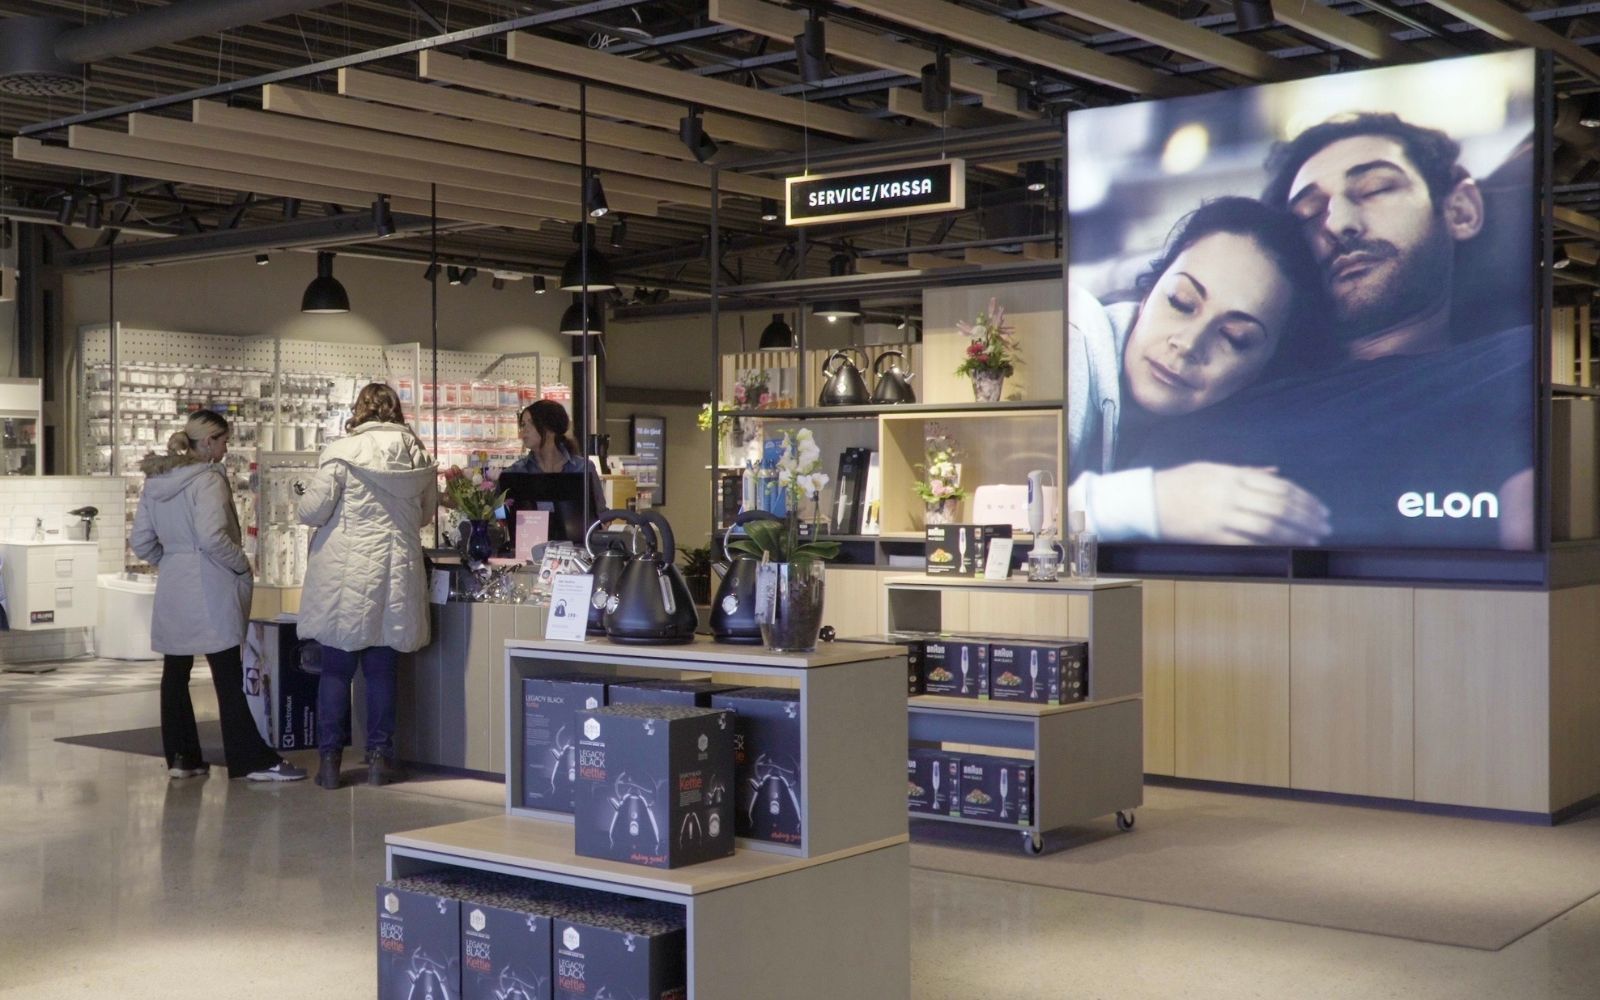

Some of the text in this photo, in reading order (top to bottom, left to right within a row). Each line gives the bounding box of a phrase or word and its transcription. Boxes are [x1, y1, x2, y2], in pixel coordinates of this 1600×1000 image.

[808, 178, 932, 207] SERVICE/KASSA
[579, 749, 606, 760] LEGACY
[579, 758, 606, 769] BLACK
[580, 767, 607, 780] Kettle
[380, 921, 404, 933] LEGACY
[380, 929, 404, 942] BLACK
[465, 938, 491, 951] LEGACY
[465, 946, 491, 960] BLACK
[558, 958, 585, 971] LEGACY
[558, 966, 585, 980] BLACK
[558, 976, 585, 992] Kettle
